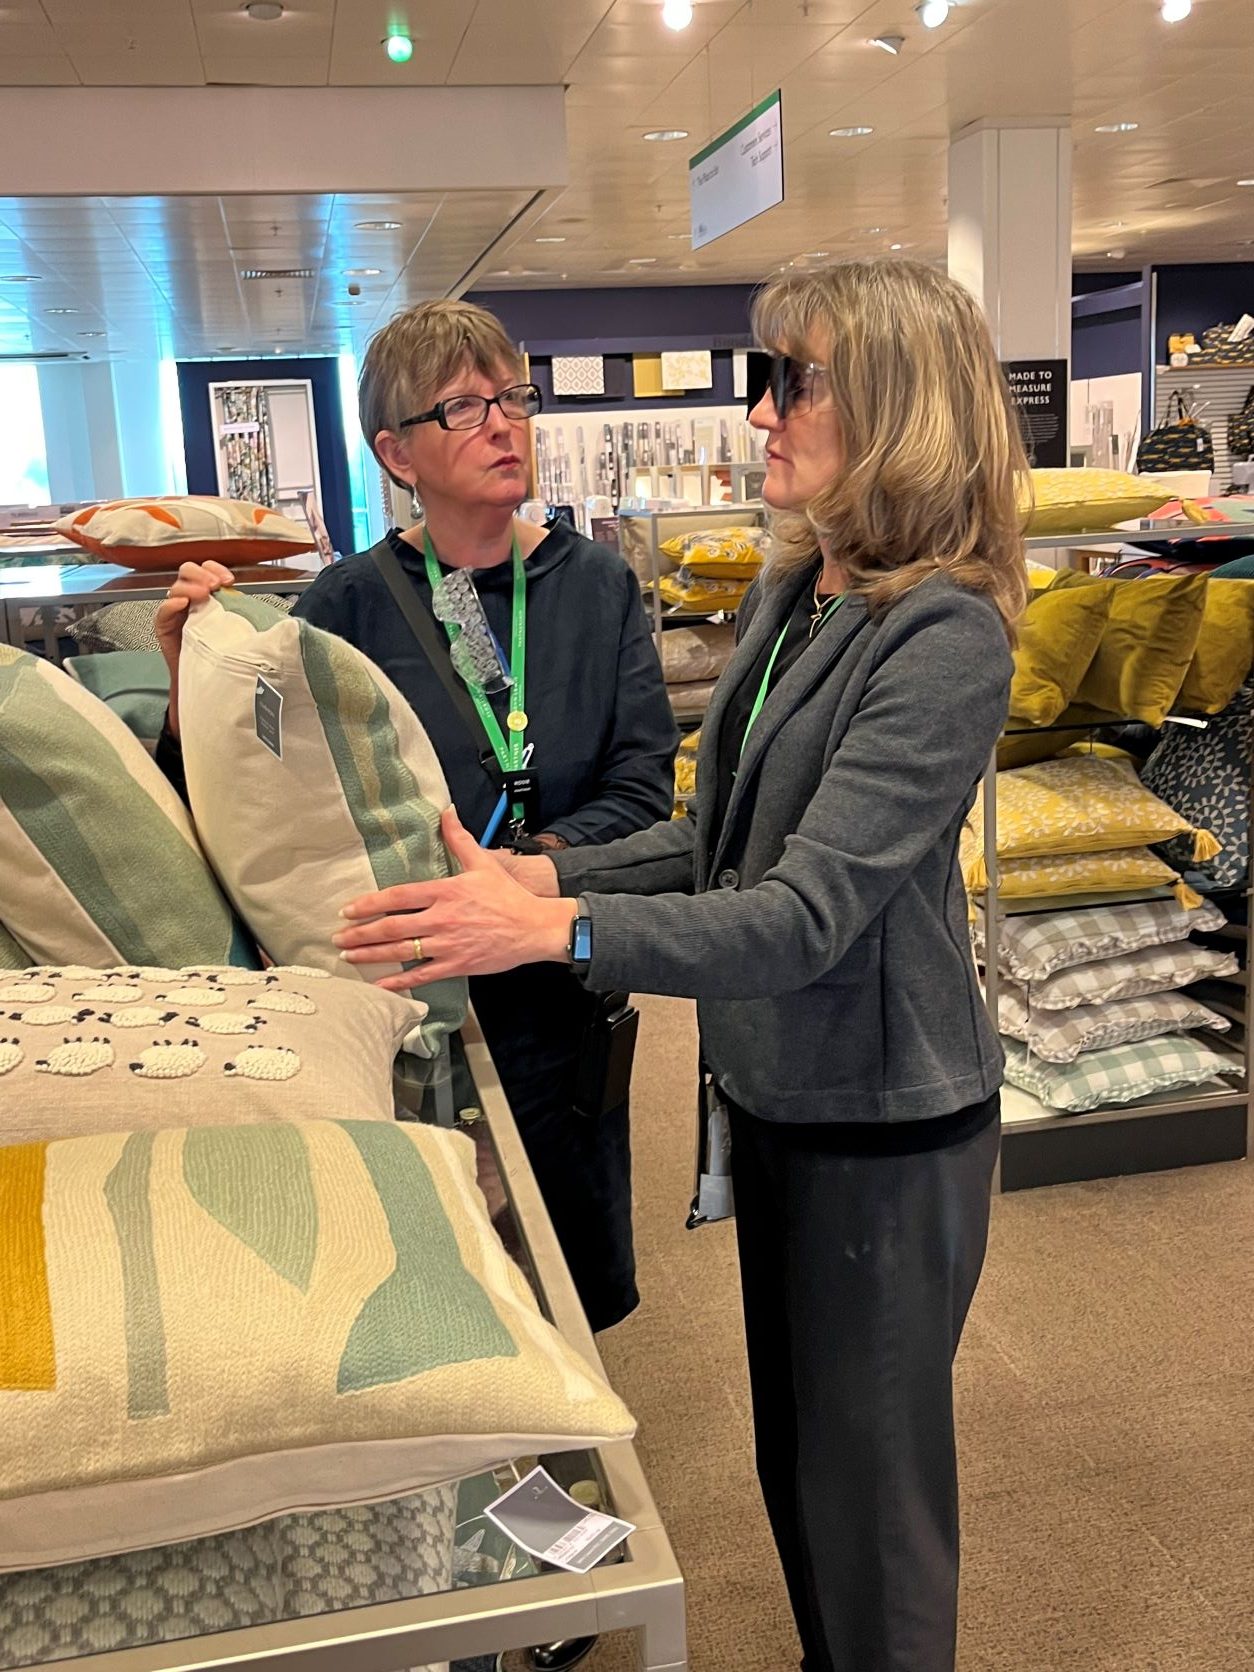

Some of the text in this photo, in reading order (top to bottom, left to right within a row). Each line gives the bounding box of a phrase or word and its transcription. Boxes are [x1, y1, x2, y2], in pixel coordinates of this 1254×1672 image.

[1009, 371, 1053, 381] MADE TO
[1009, 383, 1052, 393] MEASURE
[1011, 396, 1050, 405] EXPRESS
